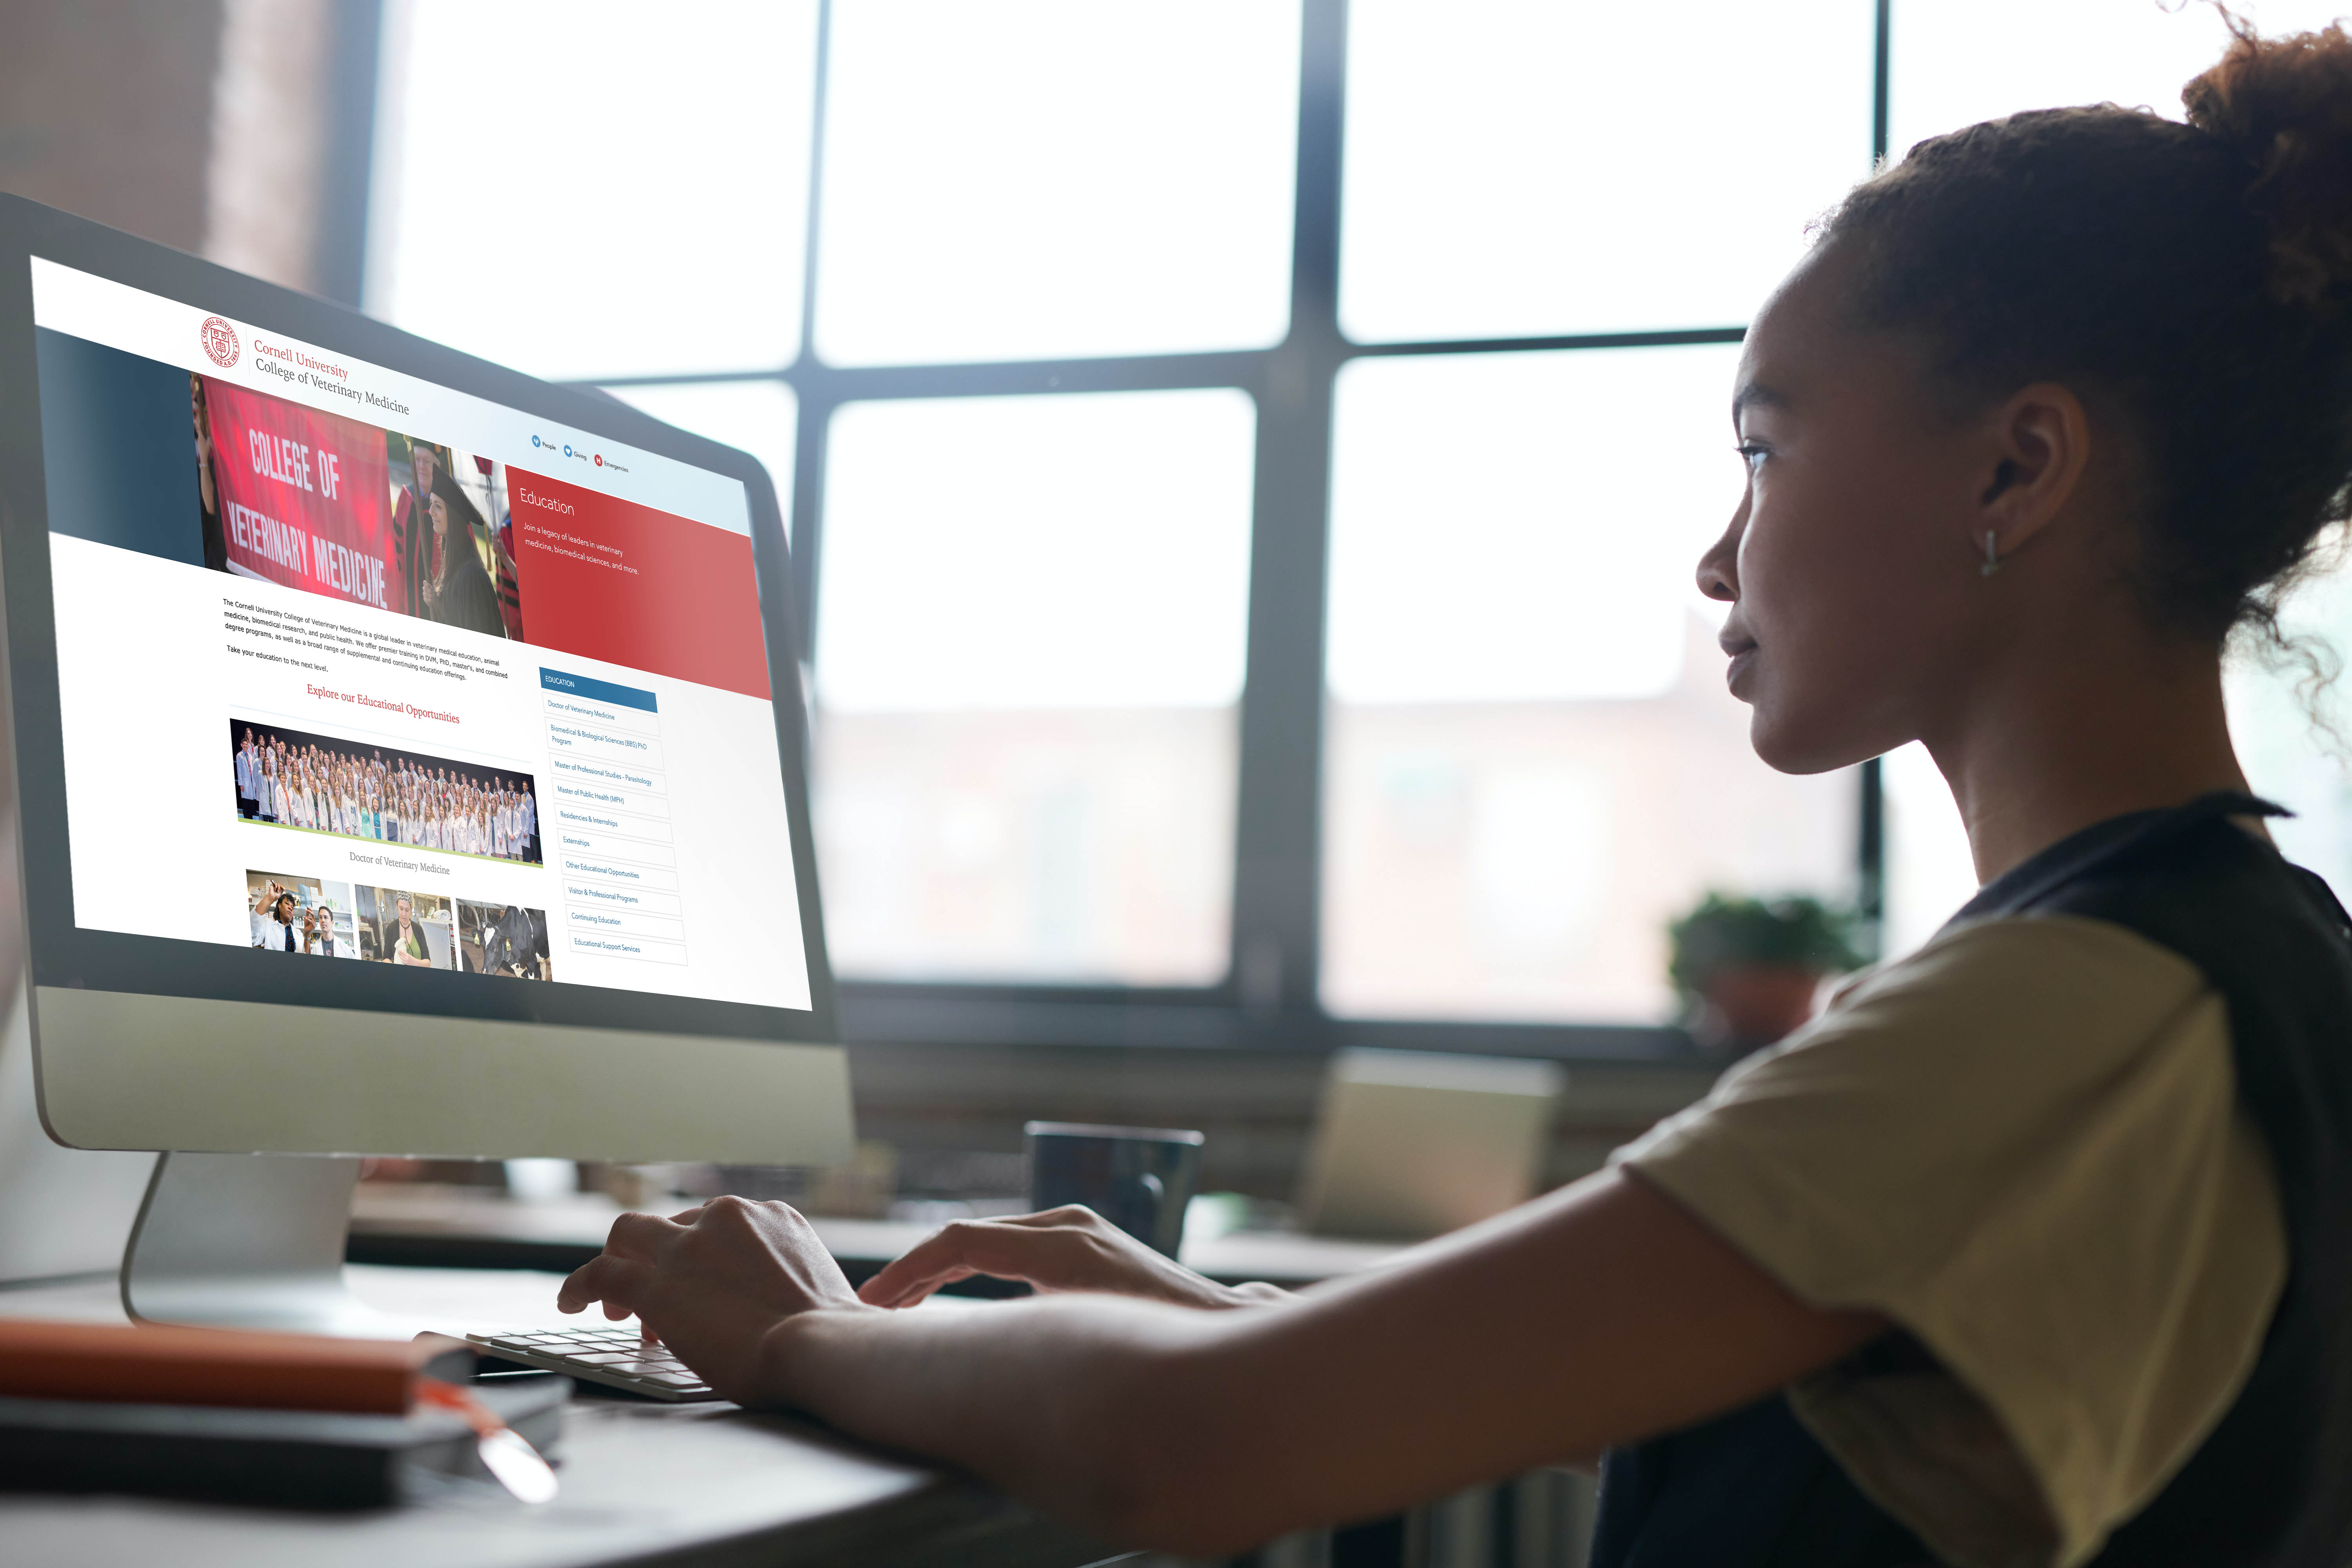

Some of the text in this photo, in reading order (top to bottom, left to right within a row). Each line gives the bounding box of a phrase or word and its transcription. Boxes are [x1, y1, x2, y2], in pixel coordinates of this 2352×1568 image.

[202, 319, 238, 348] CORNELL UNIVERSITY
[204, 341, 223, 365] FOUNDED
[254, 340, 348, 382] Cornell University
[256, 358, 409, 415] College of Veterinary Medicine
[543, 441, 556, 450] People
[574, 452, 587, 461] Giving
[249, 428, 339, 500] COLLEGE OF
[604, 461, 628, 472] Emergencies
[520, 488, 574, 516] Education
[524, 522, 535, 532] Join
[542, 527, 560, 540] legacy
[568, 534, 589, 546] leaders
[596, 544, 622, 557] veterinary
[227, 500, 388, 610] VETERINARY MEDICINE
[525, 539, 553, 552] medicine,
[554, 544, 585, 560] biomedical
[586, 555, 611, 568] sciences,
[624, 566, 639, 575] more.
[235, 601, 254, 611] Cornell
[256, 606, 282, 619] University
[284, 613, 303, 622] College
[311, 619, 338, 631] Veterinary
[340, 625, 362, 635] Medicine
[390, 636, 405, 644] leader
[413, 643, 437, 653] veterinary
[458, 653, 482, 663] education,
[224, 612, 250, 623] medicine,
[252, 617, 280, 628] biomedical
[283, 625, 307, 635] research,
[336, 635, 354, 644] health.
[399, 650, 418, 660] training
[425, 655, 438, 664] DVM,
[440, 659, 451, 667] PhD,
[452, 662, 474, 672] master's,
[486, 670, 508, 679] combined
[225, 622, 244, 632] degree
[246, 628, 273, 639] programs,
[307, 640, 322, 649] broad
[347, 650, 380, 661] supplemental
[393, 661, 418, 671] continuing
[420, 666, 443, 675] education
[444, 671, 466, 681] offerings.
[227, 645, 240, 653] Take
[256, 652, 282, 662] education
[314, 664, 328, 672] level.
[545, 675, 575, 688] EDUCATION
[307, 684, 459, 724] Explore our Educational Opportunities
[548, 700, 564, 709] Doctor
[570, 705, 593, 717] Veterinary
[594, 710, 615, 720] Medicine
[551, 724, 576, 735] Biomedical
[582, 731, 604, 741] Biological
[605, 736, 624, 745] Sciences
[625, 740, 637, 749] (BBS)
[552, 736, 572, 745] Program
[555, 760, 570, 769] Master
[577, 765, 604, 776] Professional
[605, 770, 621, 779] Studies
[625, 774, 652, 786] Parasitology
[557, 786, 573, 794] Master
[580, 790, 594, 798] Public
[595, 793, 609, 801] Health
[610, 796, 624, 804] (MPH)
[560, 811, 588, 821] Residencies
[593, 817, 618, 828] Internships
[563, 836, 590, 848] Externships
[350, 852, 450, 875] Doctor of Veterinary Medicine
[581, 864, 607, 873] Educational
[608, 868, 639, 878] Opportunities
[589, 889, 616, 900] Professional
[617, 894, 638, 903] Programs
[572, 913, 621, 925] Continuing Education
[574, 938, 640, 953] Educational Support Services
